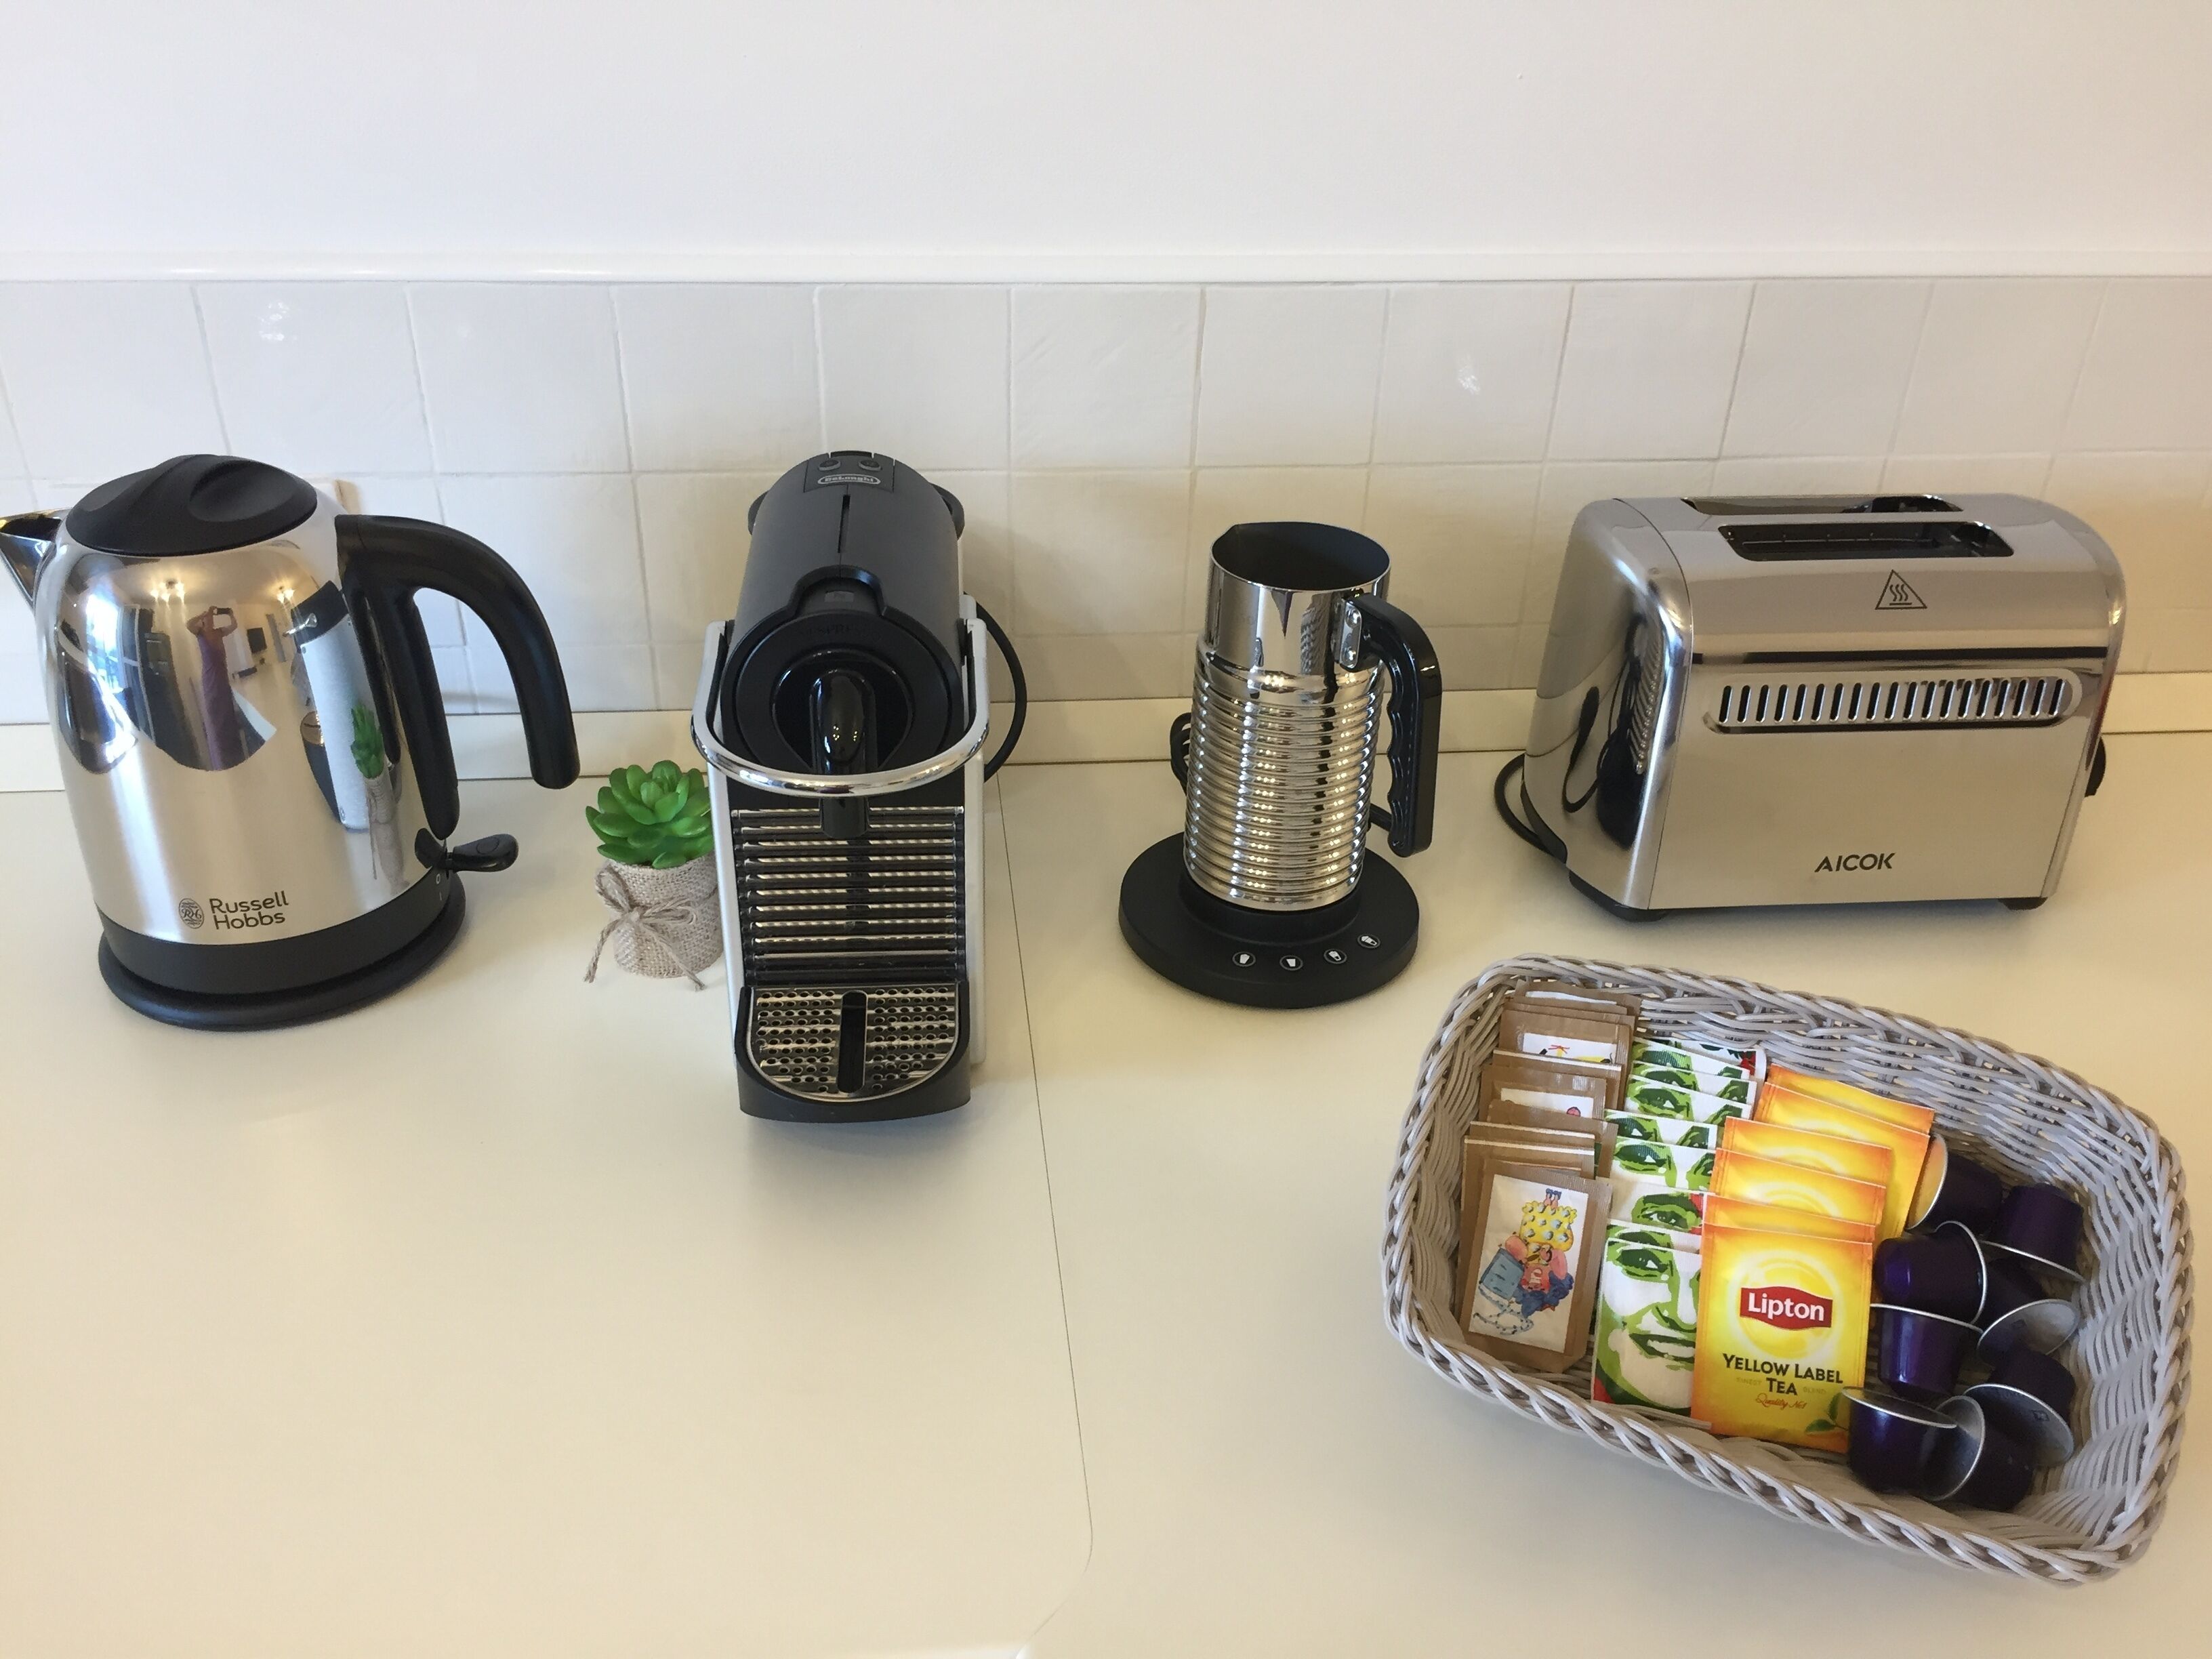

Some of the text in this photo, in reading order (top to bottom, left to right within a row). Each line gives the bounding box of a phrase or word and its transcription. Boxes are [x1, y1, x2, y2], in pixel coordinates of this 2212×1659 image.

[1814, 853, 1896, 873] AICOK
[209, 890, 289, 914] Russell
[213, 912, 285, 930] Hobbs
[1748, 1292, 1824, 1321] Lipton
[1723, 1353, 1843, 1384] YELLOW LABEL
[1766, 1377, 1798, 1396] TEA
[1755, 1393, 1788, 1410] Quality
